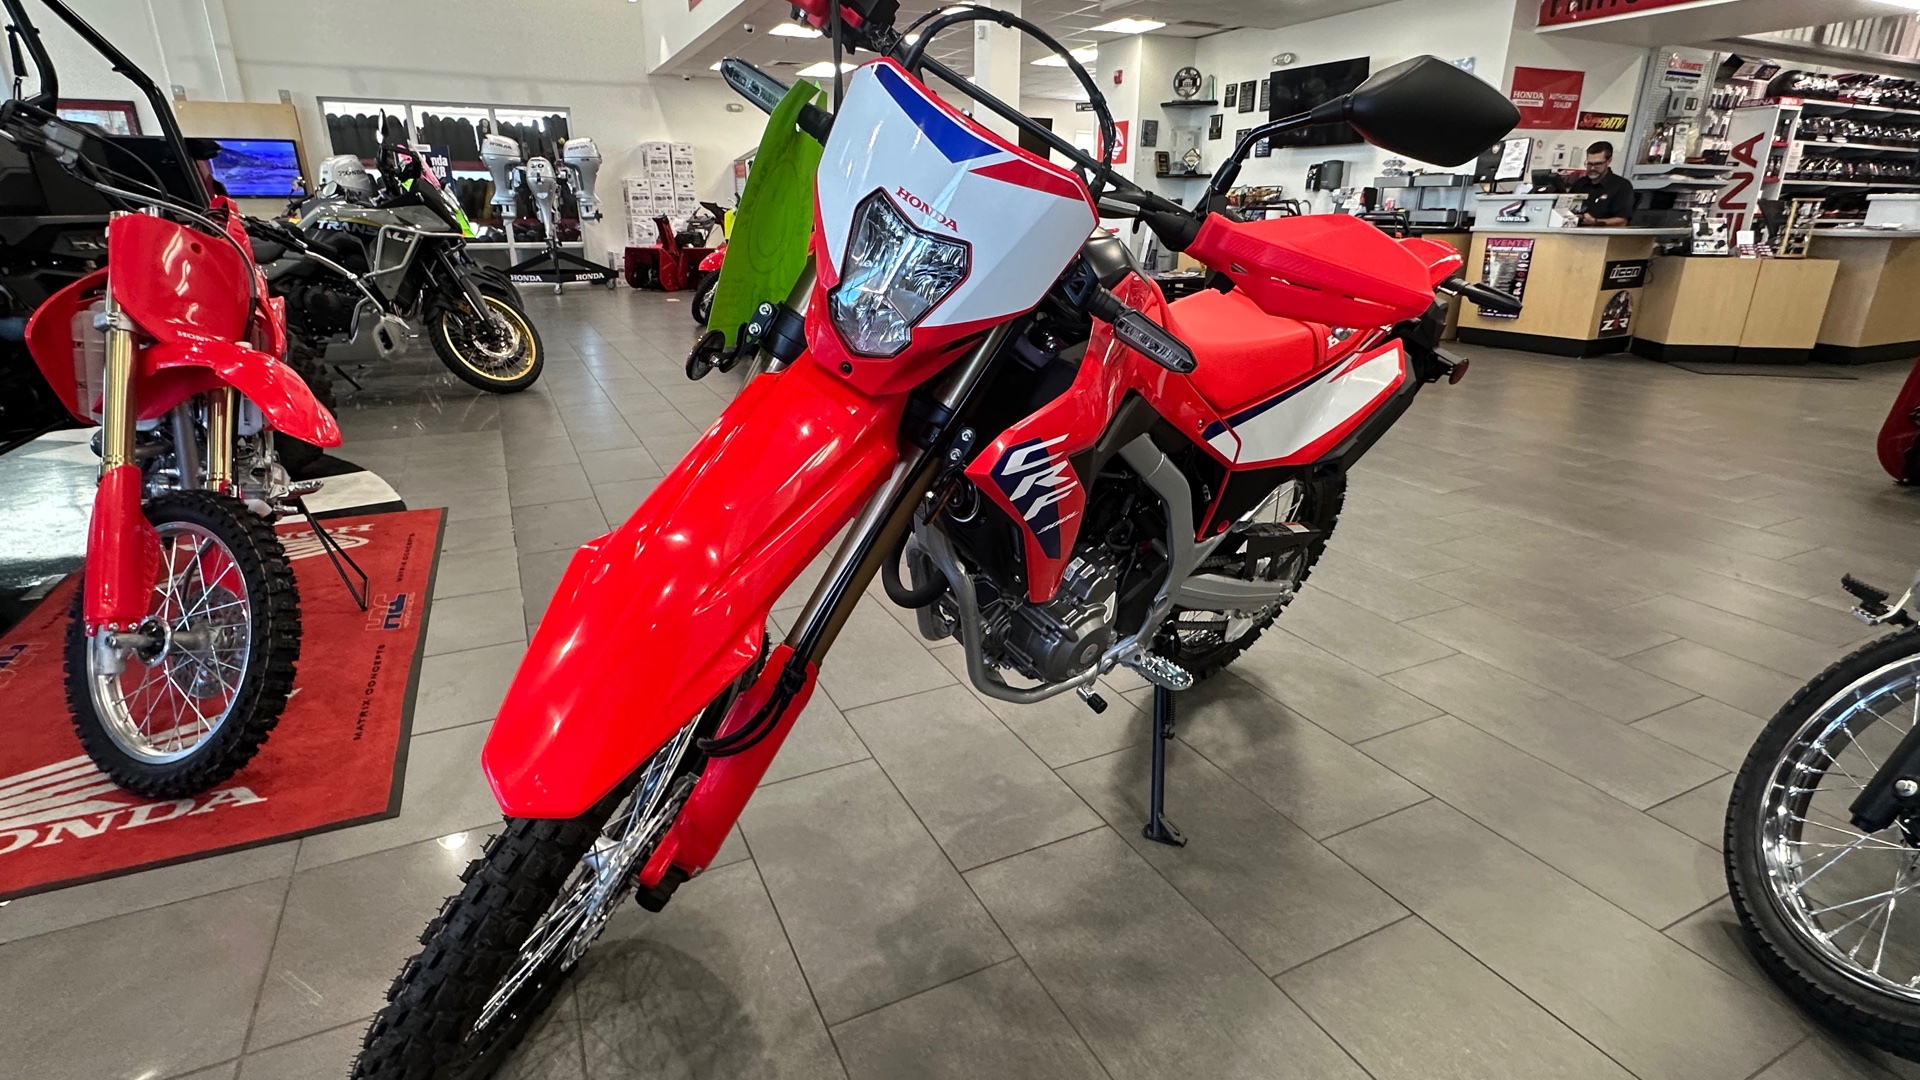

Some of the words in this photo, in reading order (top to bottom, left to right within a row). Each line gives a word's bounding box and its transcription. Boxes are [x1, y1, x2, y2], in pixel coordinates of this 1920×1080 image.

[1513, 90, 1544, 99] HONDA
[1549, 93, 1579, 101] AUTHORIZED
[1553, 101, 1572, 109] DEALER
[428, 154, 449, 167] nda
[1716, 131, 1765, 249] ENA
[895, 186, 958, 233] HONDA
[1496, 215, 1527, 223] HONDA
[510, 274, 542, 283] HONDA
[575, 272, 605, 281] HONDA
[353, 699, 371, 741] MATRIX
[365, 643, 386, 696] CONCEPTS
